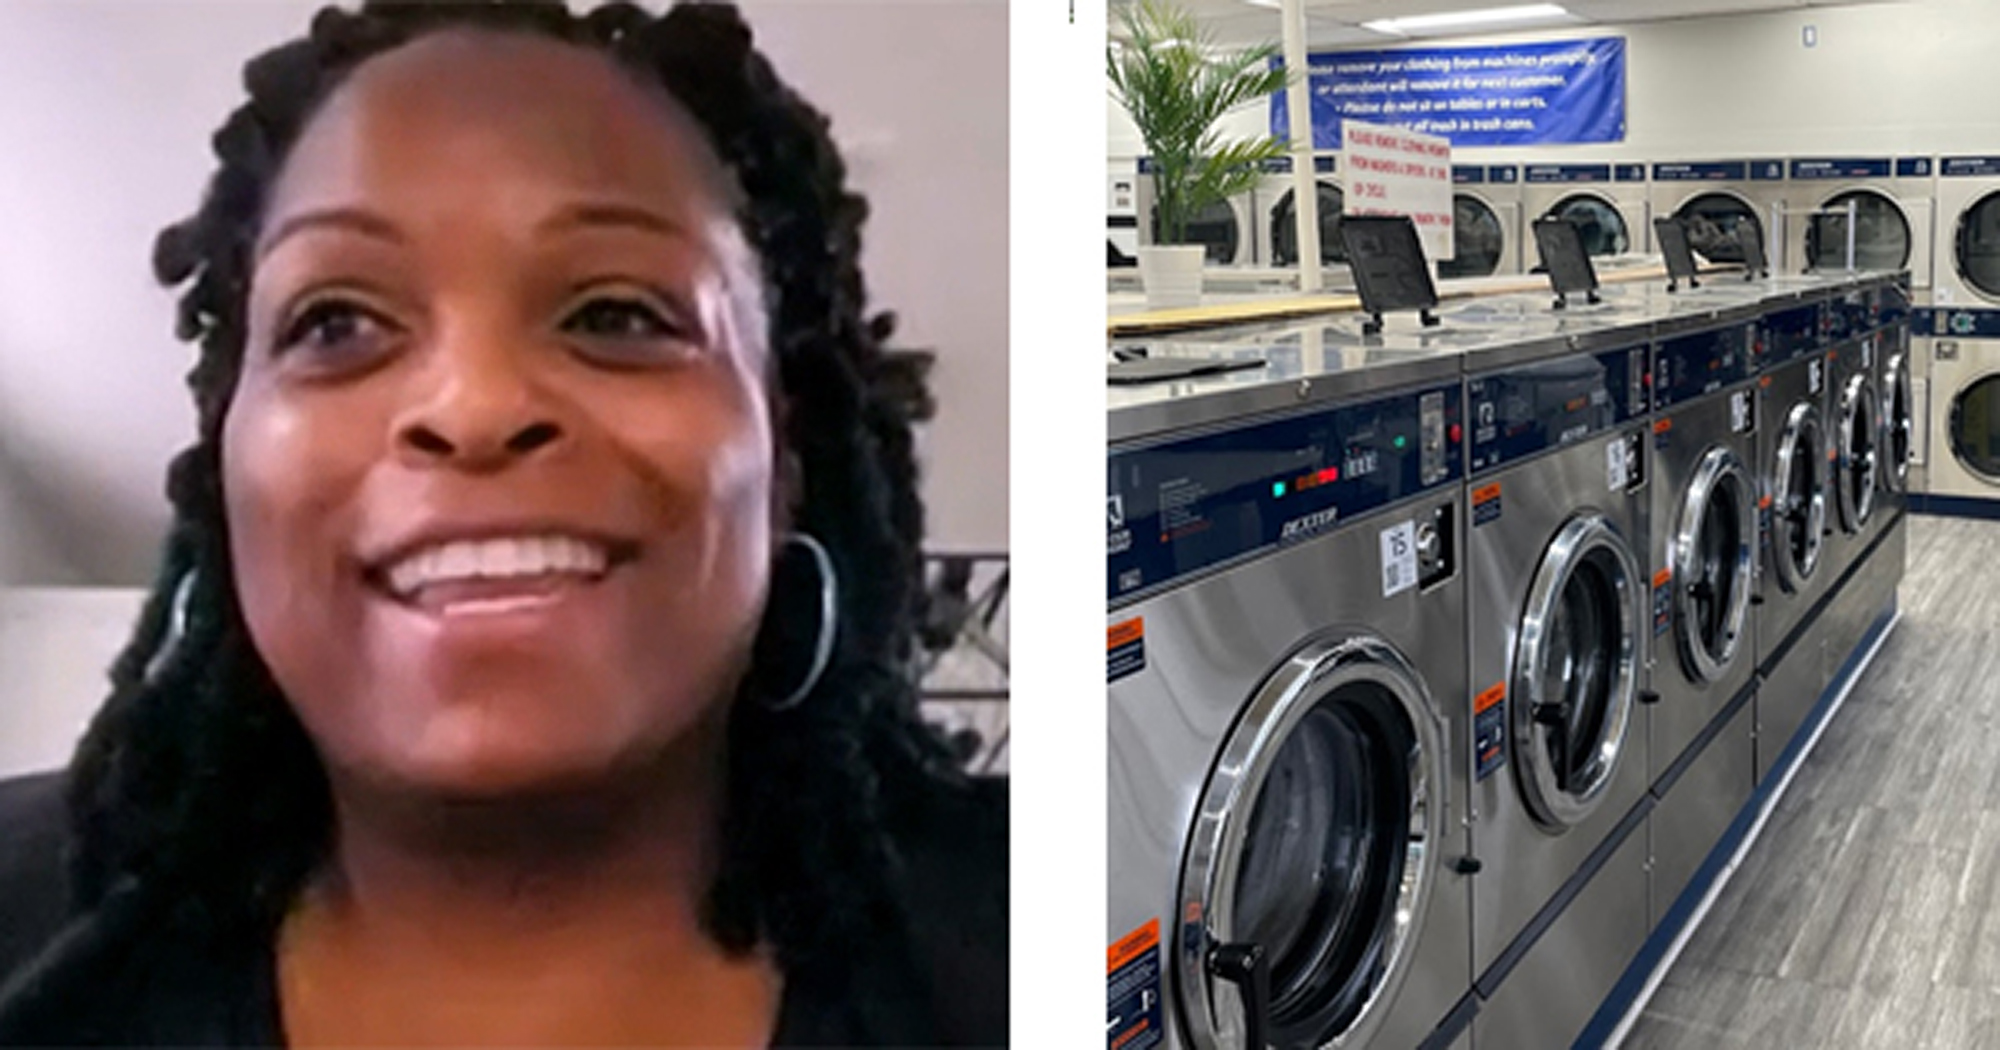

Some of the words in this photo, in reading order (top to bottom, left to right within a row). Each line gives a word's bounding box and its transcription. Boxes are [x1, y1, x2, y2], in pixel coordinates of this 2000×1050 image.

[1337, 63, 1376, 74] remove
[1378, 62, 1400, 76] your
[1403, 58, 1448, 73] clothing
[1453, 57, 1480, 70] from
[1483, 54, 1537, 68] machines
[1318, 85, 1331, 95] or
[1333, 81, 1387, 94] attendant
[1389, 79, 1407, 91] will
[1410, 81, 1450, 91] remove
[1452, 78, 1460, 89] it
[1463, 76, 1479, 90] for
[1481, 76, 1507, 89] next
[1342, 101, 1380, 113] Please
[1383, 100, 1396, 113] do
[1399, 101, 1417, 112] not
[1419, 100, 1431, 112] sit
[1450, 98, 1484, 110] tables
[1486, 99, 1497, 110] or
[1500, 98, 1511, 108] in
[1460, 119, 1470, 130] in
[1473, 117, 1500, 131] trash
[1281, 506, 1338, 538] DEXTER
